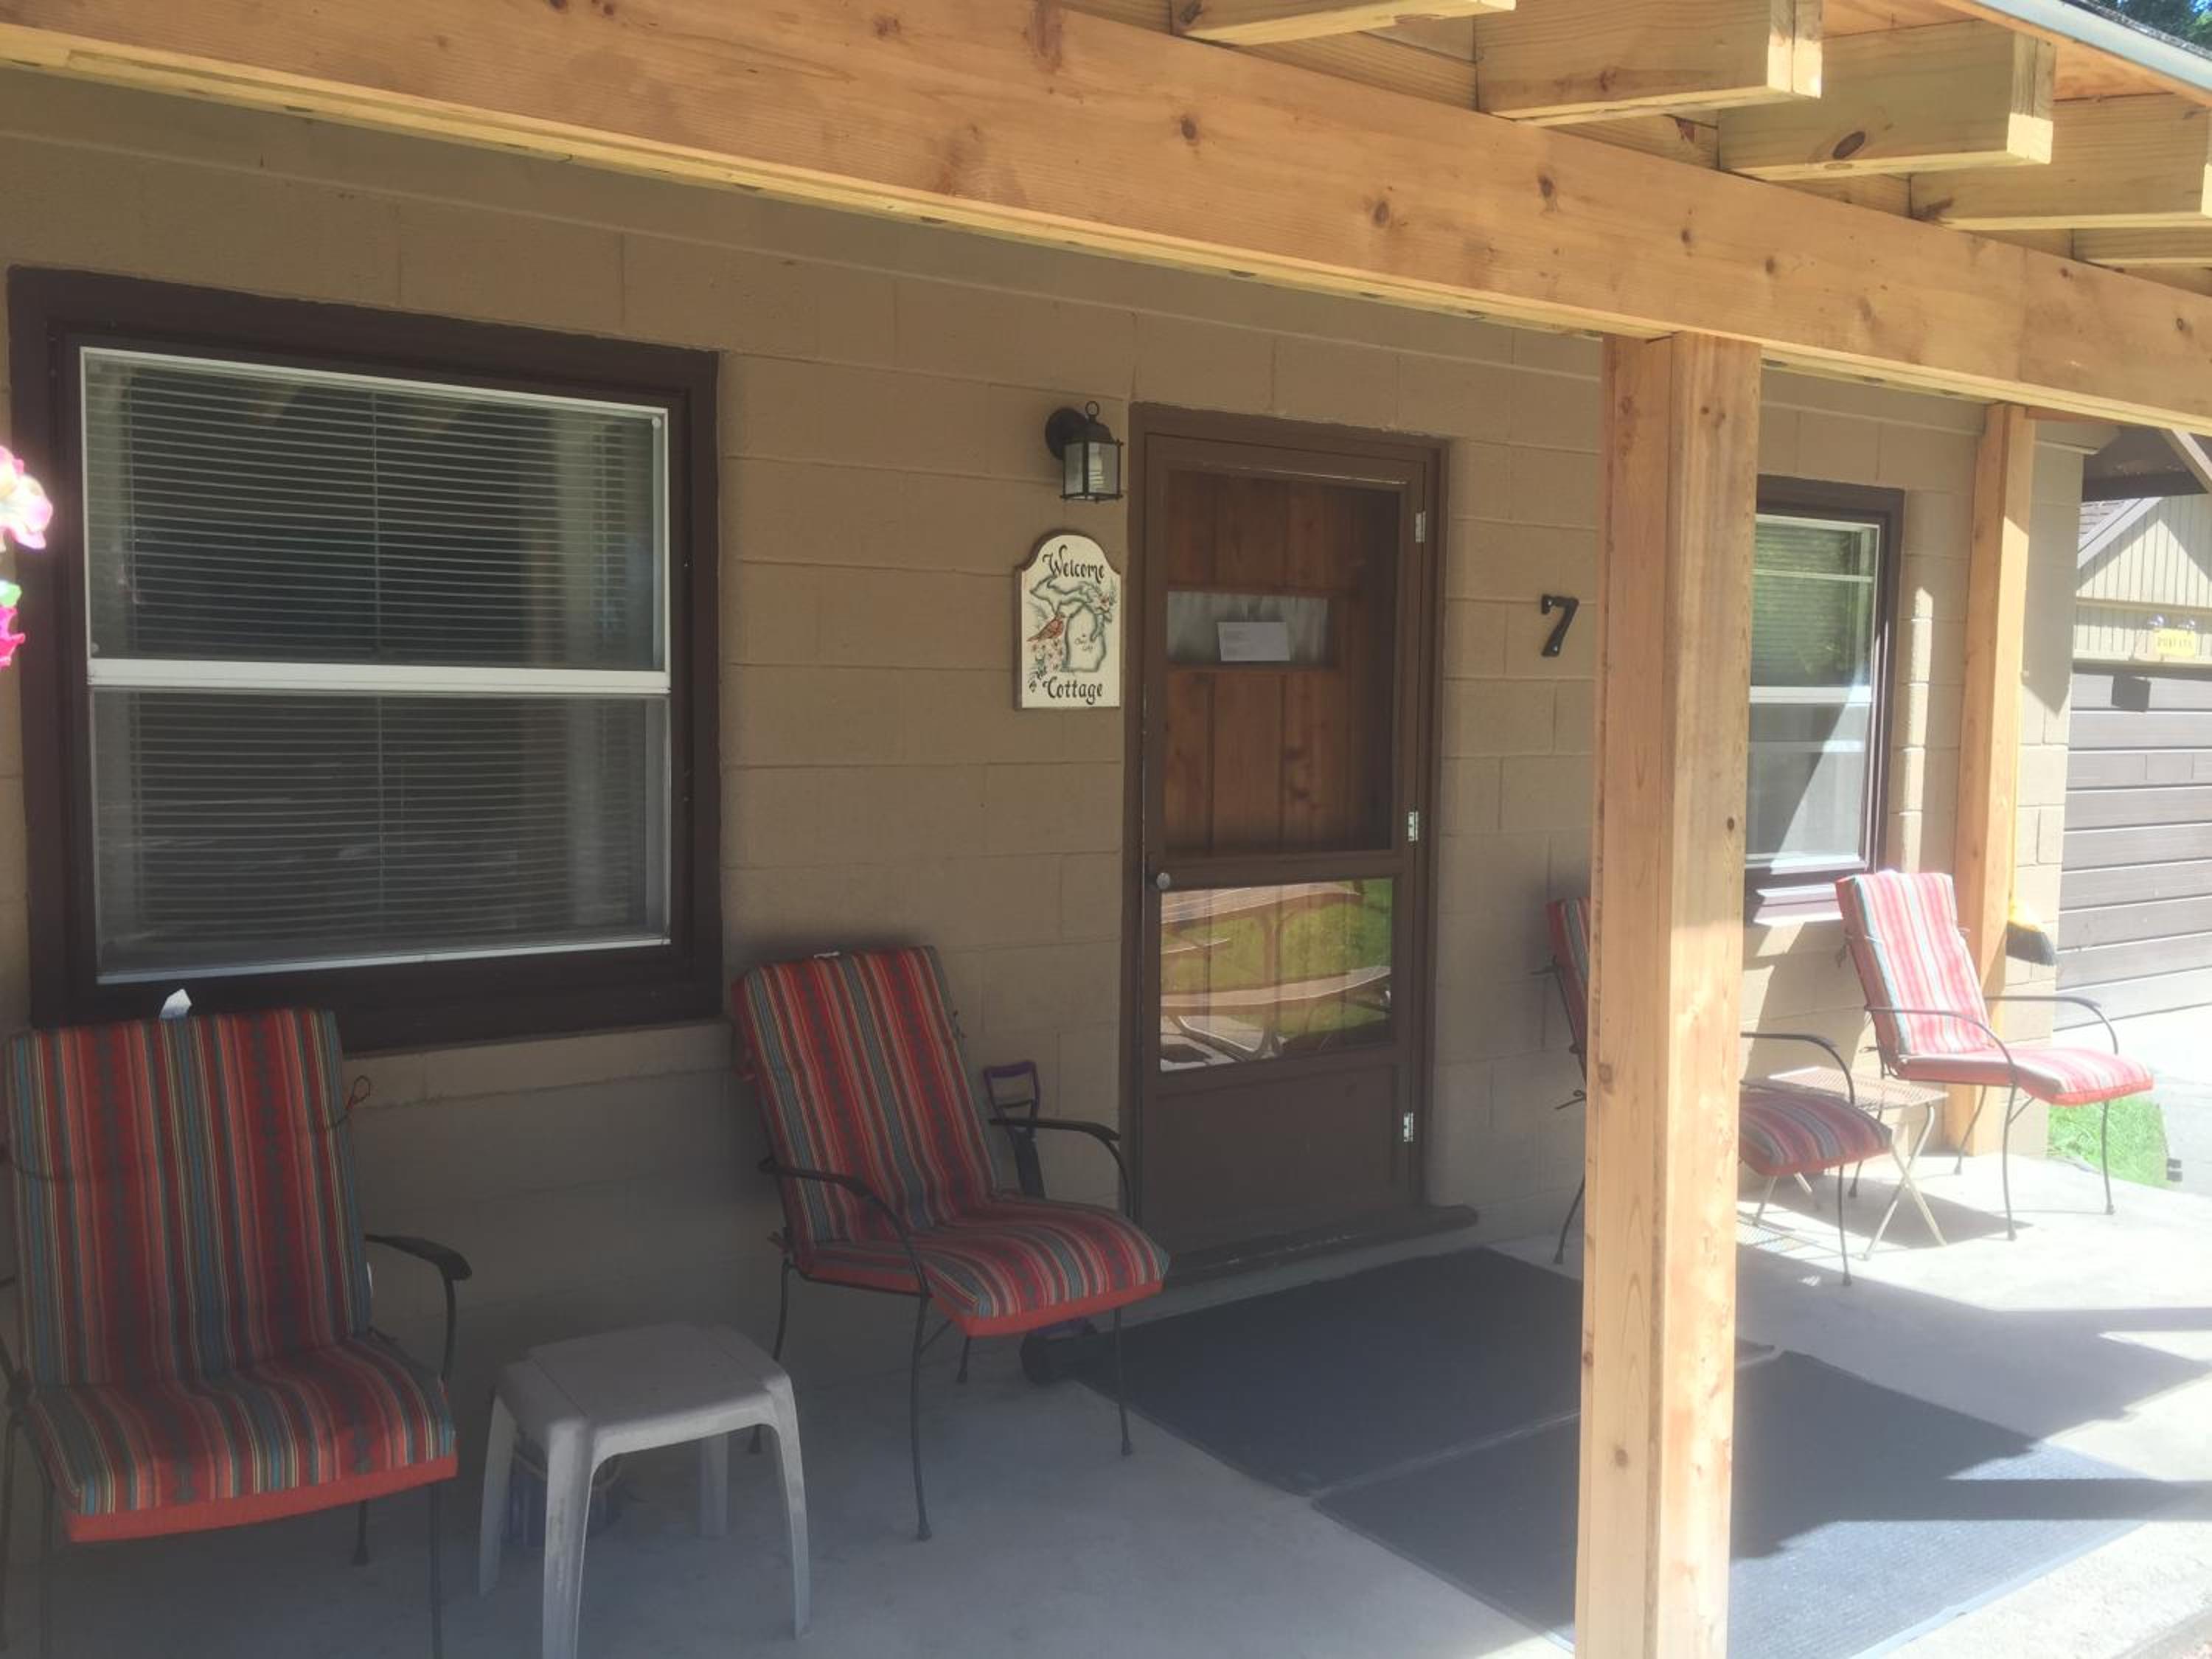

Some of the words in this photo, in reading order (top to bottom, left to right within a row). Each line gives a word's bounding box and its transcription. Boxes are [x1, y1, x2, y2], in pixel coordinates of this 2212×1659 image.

[1042, 544, 1105, 583] Welcome
[1540, 594, 1579, 657] 7
[1042, 675, 1104, 706] Cottage
